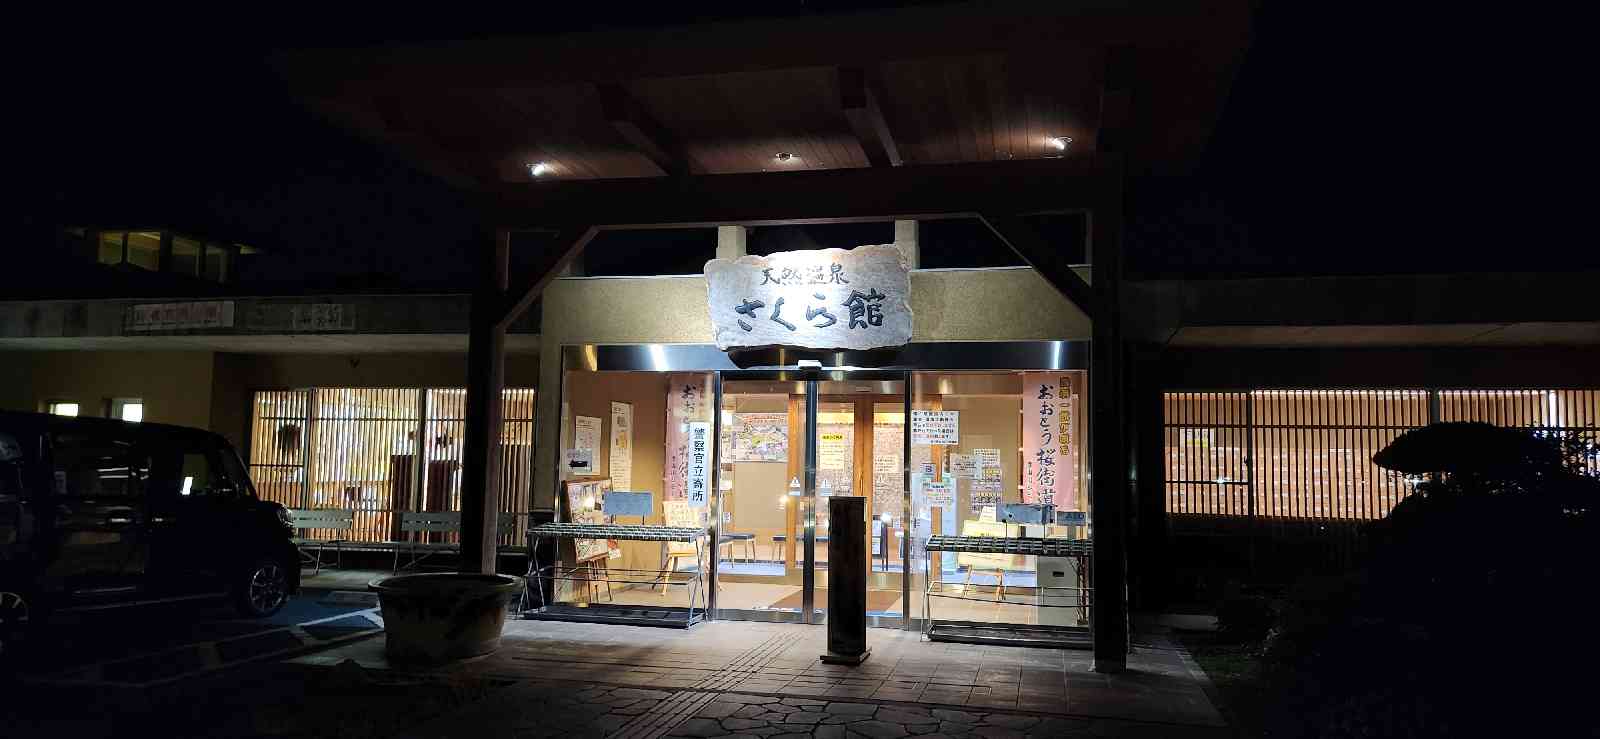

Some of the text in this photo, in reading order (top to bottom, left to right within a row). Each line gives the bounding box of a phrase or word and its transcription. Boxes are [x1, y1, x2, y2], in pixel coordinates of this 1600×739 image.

[759, 262, 850, 287] 天然温泉
[733, 286, 886, 332] さくら館
[692, 427, 705, 502] 警察官立寄所
[1036, 383, 1057, 507] おおとう桜街道
